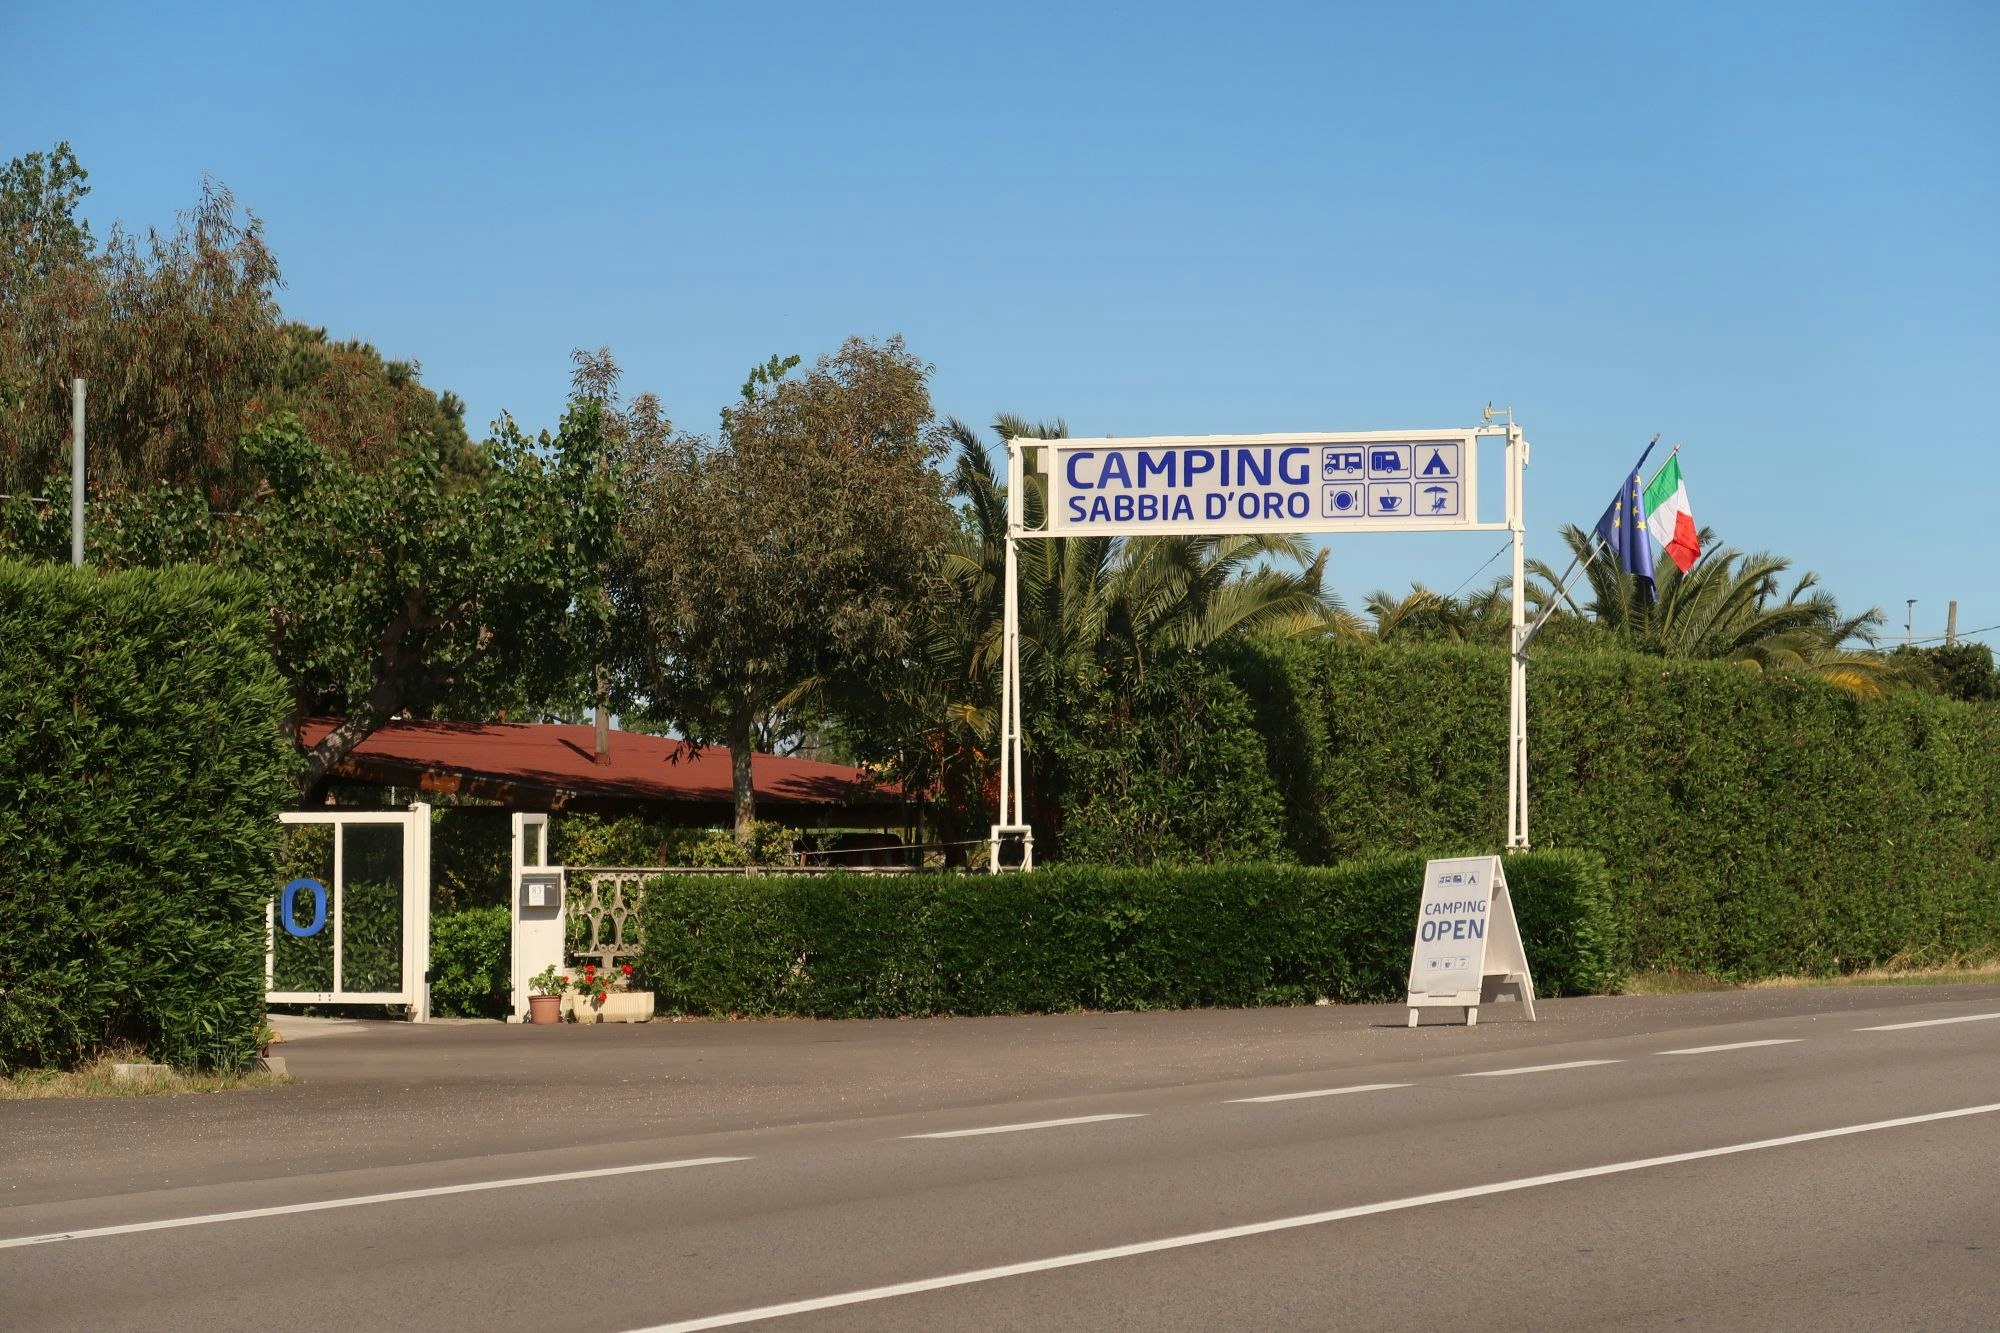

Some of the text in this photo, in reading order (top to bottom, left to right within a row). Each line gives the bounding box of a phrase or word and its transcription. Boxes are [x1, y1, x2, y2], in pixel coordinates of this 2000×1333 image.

[1066, 447, 1310, 489] CAMPING
[1068, 493, 1195, 522] SABBIA
[1424, 900, 1486, 916] CAMPING
[1421, 919, 1485, 943] OPEN
